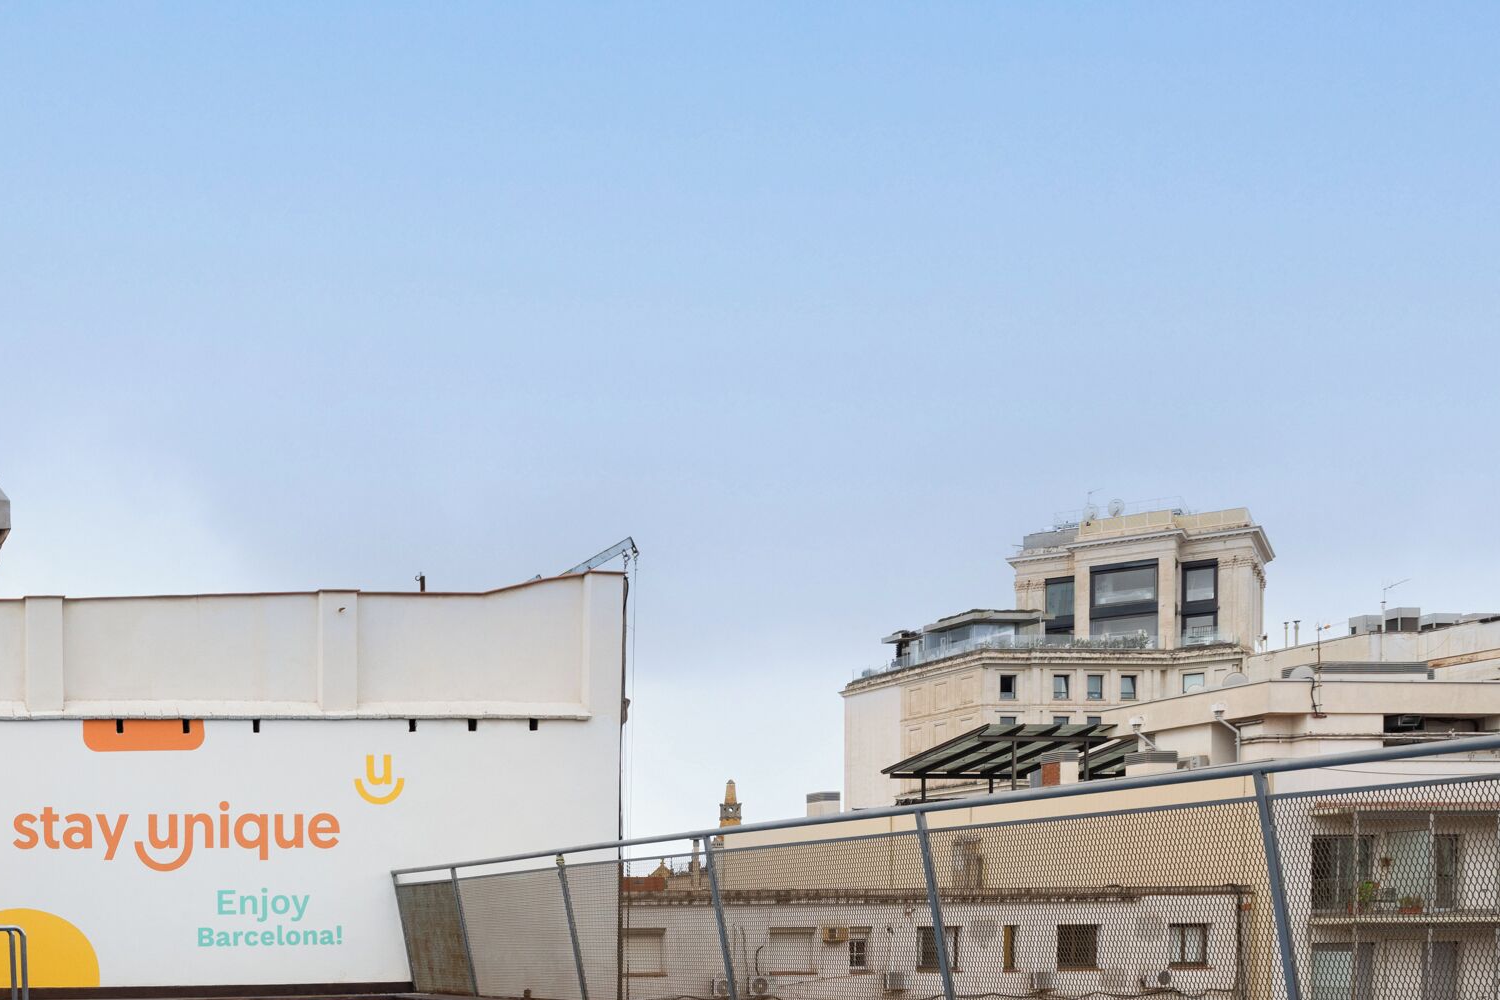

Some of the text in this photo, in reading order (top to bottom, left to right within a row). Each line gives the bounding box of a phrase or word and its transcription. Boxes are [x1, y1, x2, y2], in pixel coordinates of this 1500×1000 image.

[366, 753, 392, 785] u
[12, 800, 341, 872] stay unique
[216, 887, 310, 922] Enjoy
[197, 925, 343, 948] Barcelona!
